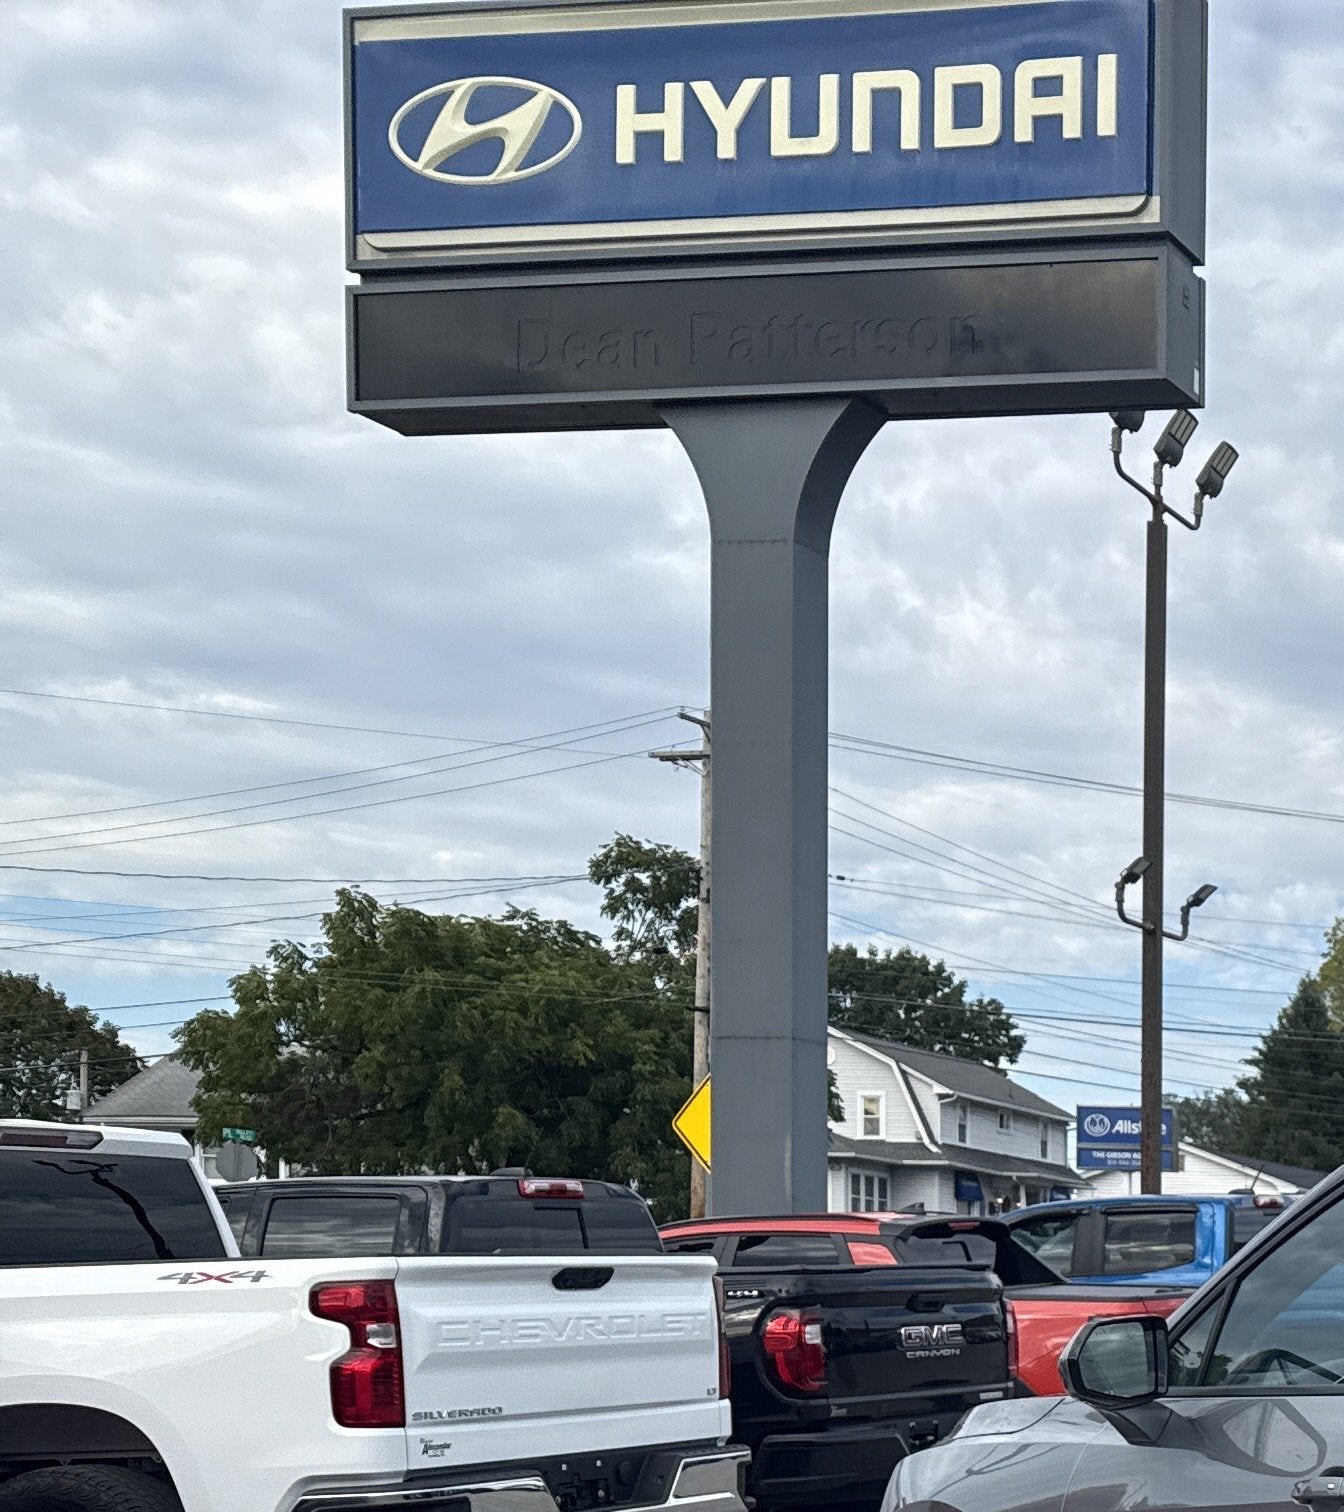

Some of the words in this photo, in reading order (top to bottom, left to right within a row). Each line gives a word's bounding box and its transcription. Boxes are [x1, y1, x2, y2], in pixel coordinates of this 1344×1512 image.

[615, 53, 1118, 165] HYUNDAI
[515, 317, 662, 373] Dean
[690, 307, 980, 365] Patterson
[157, 1269, 271, 1284] 4X4
[436, 1312, 706, 1346] CHEVROLET
[900, 1323, 963, 1347] GMC
[906, 1348, 960, 1359] CANYON
[411, 1406, 503, 1421] SILVERADO
